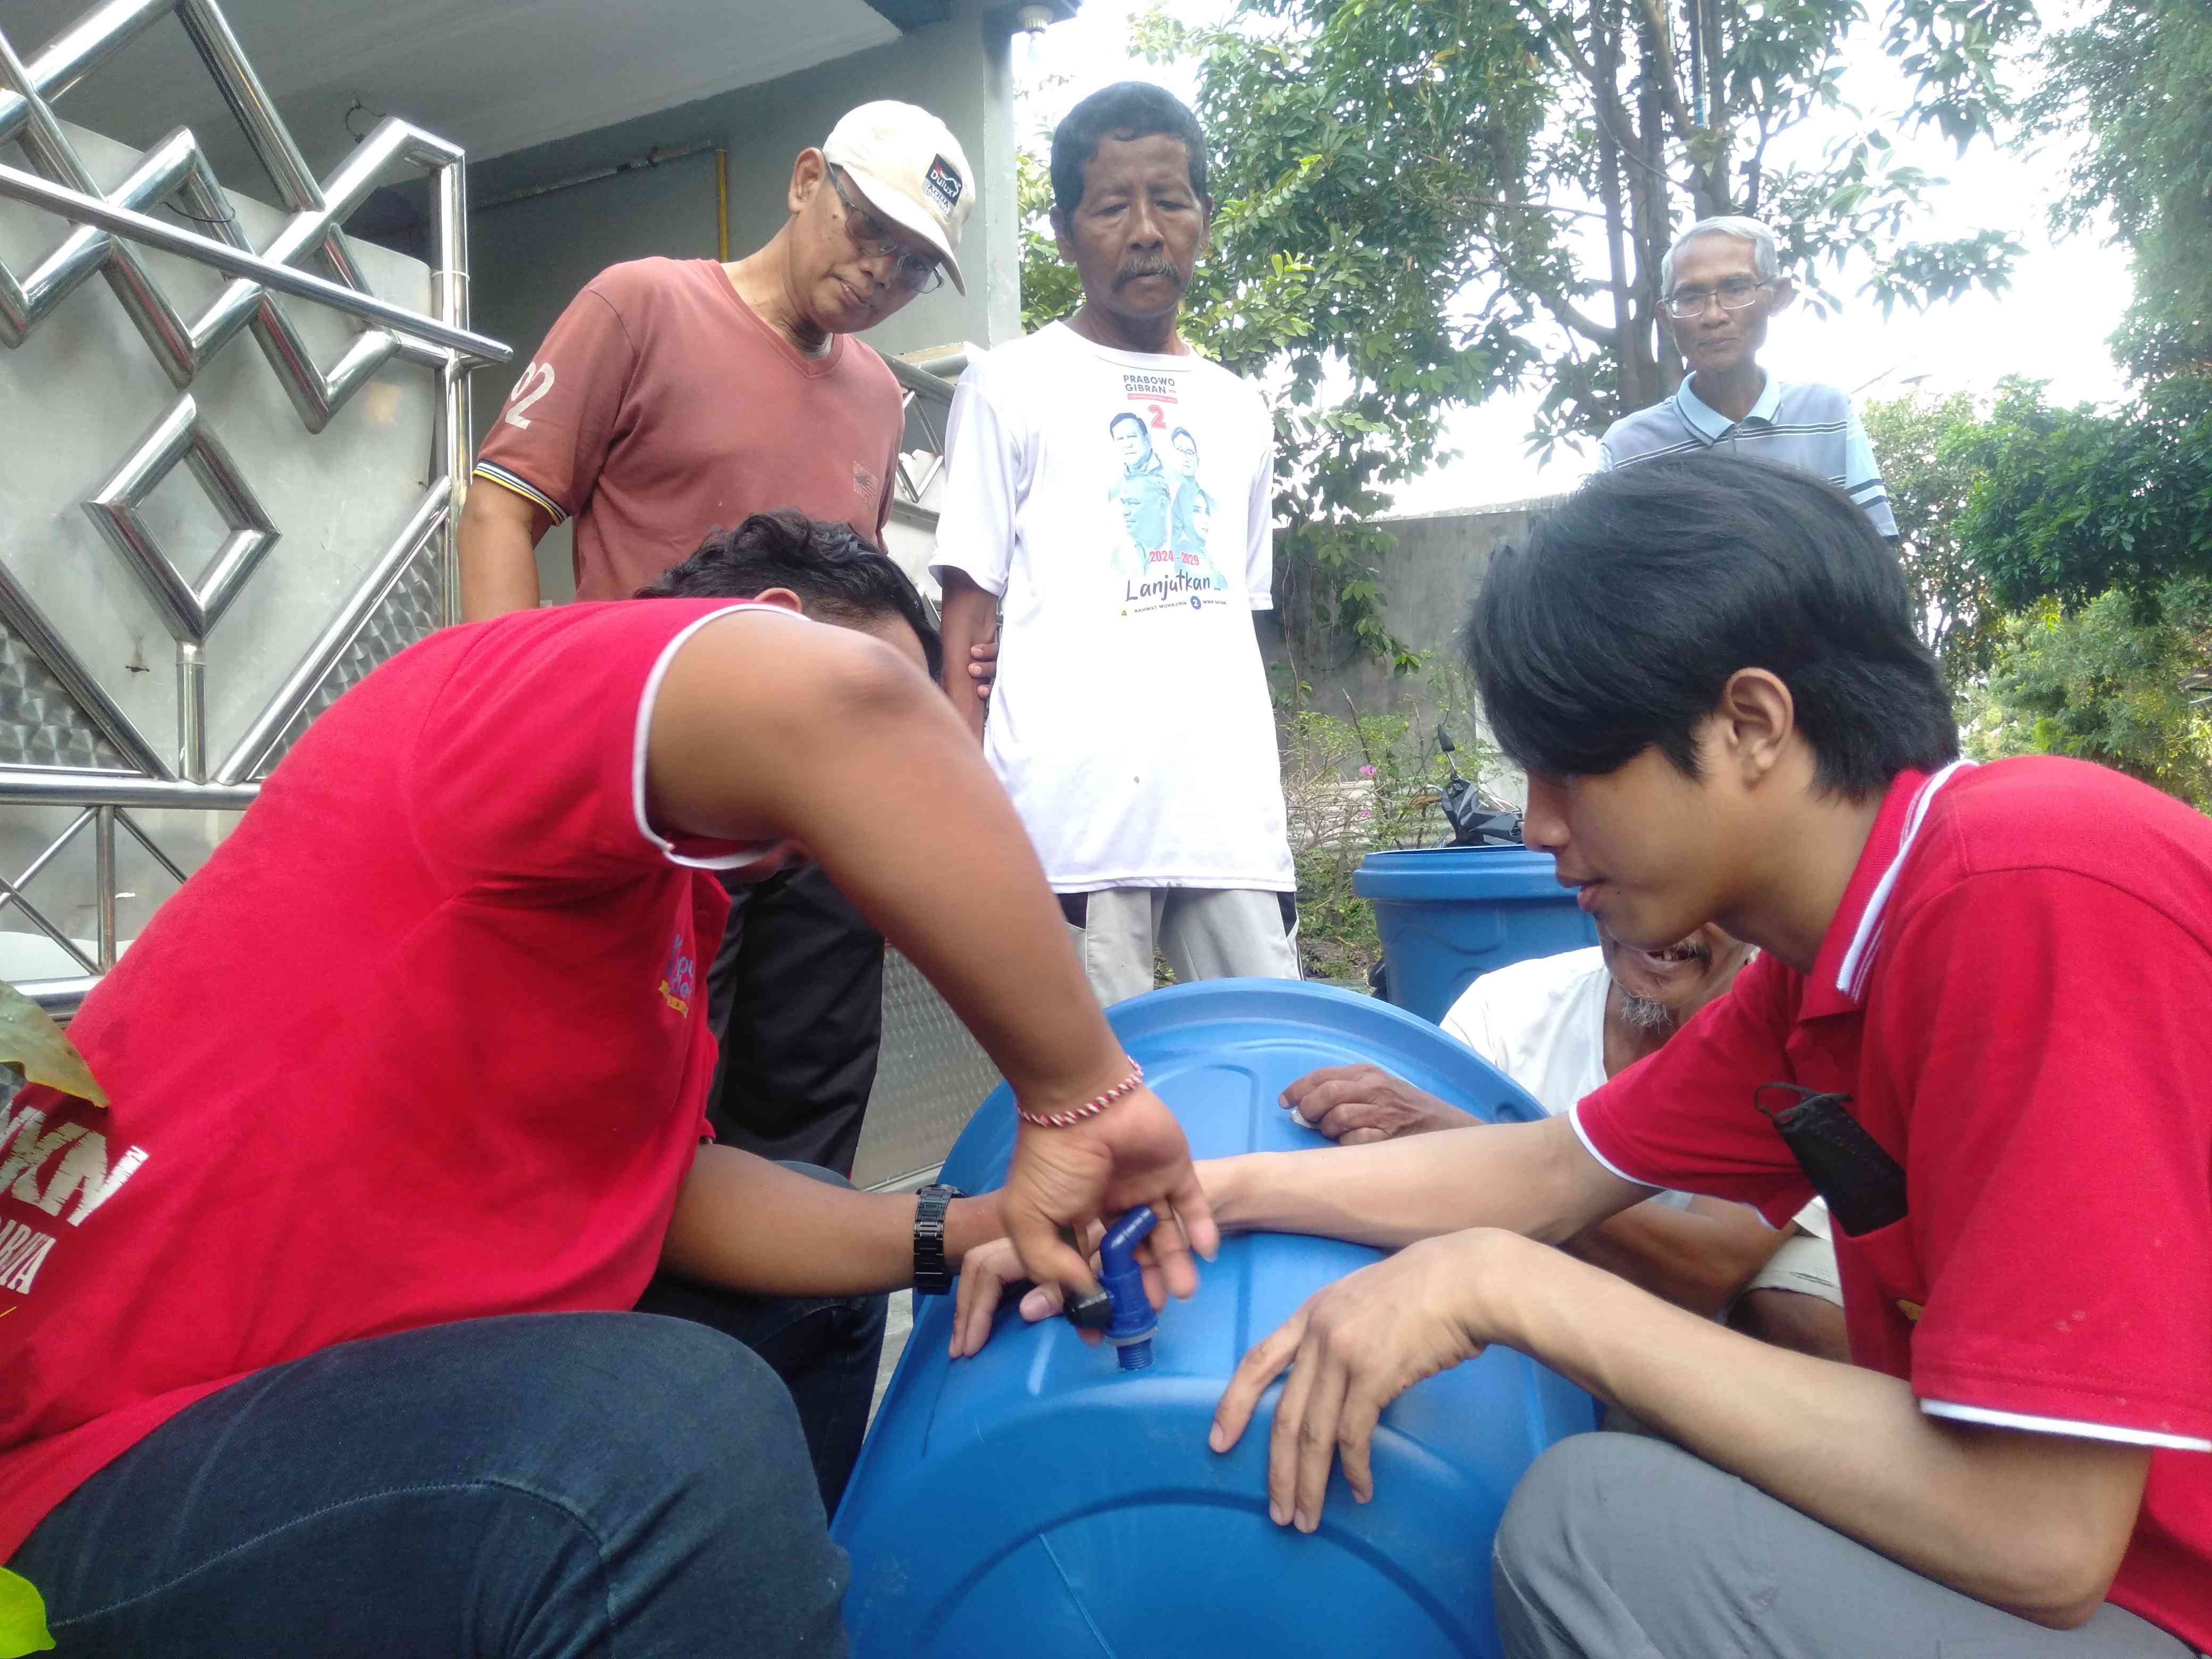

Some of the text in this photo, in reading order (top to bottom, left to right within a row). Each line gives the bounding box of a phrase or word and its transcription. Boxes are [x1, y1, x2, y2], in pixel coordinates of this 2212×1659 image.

[931, 169, 953, 197] Dulux
[1123, 375, 1175, 386] PRABOWO
[1125, 384, 1166, 394] GIBRAN
[505, 361, 555, 430] 02
[1148, 405, 1167, 430] 2
[1149, 550, 1175, 562] 2024
[1181, 552, 1200, 566] 2029
